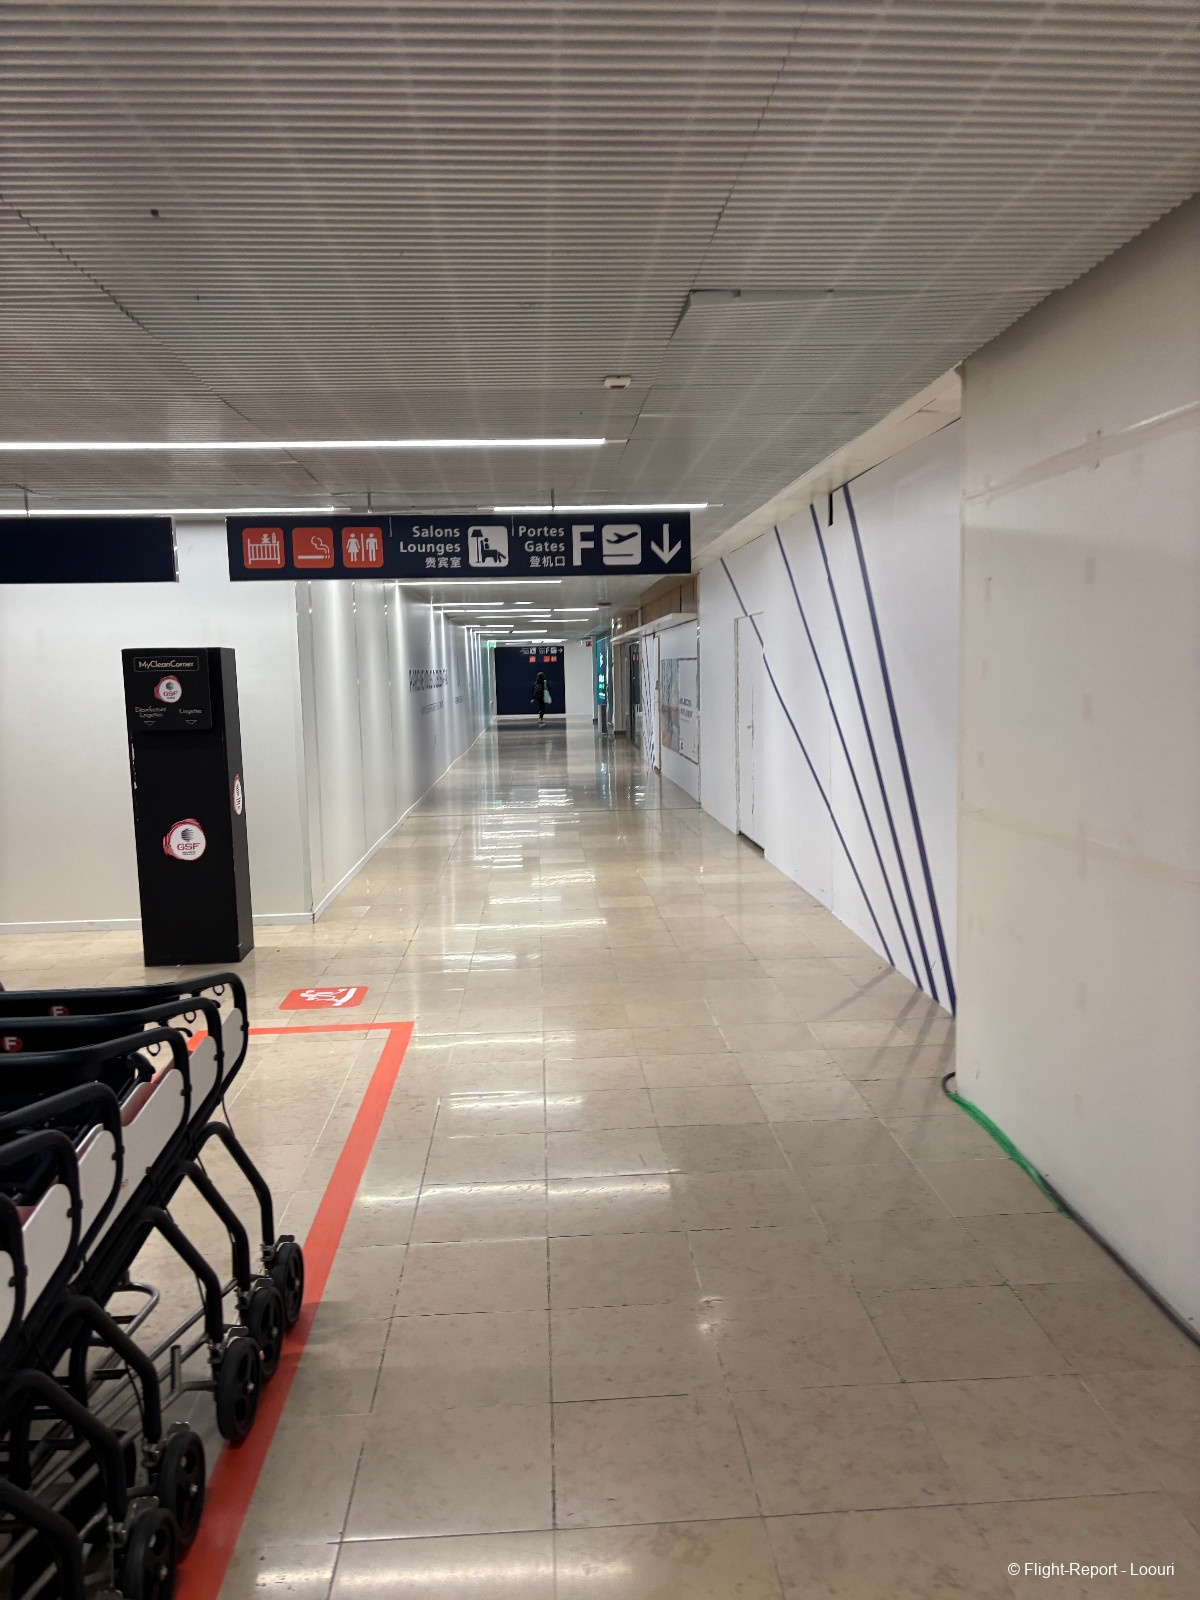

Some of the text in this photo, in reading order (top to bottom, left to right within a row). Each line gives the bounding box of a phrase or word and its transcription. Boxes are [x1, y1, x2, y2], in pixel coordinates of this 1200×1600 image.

[412, 525, 460, 538] Salons
[518, 525, 565, 537] Portes
[400, 541, 461, 556] Lounges
[524, 541, 566, 552] Gates
[572, 524, 595, 566] F
[425, 557, 462, 569] 贵宾室
[529, 556, 566, 568] 登机口
[138, 659, 195, 670] MyCleanCorner
[177, 842, 200, 851] GSF
[52, 1006, 64, 1017] F
[5, 1037, 17, 1051] F
